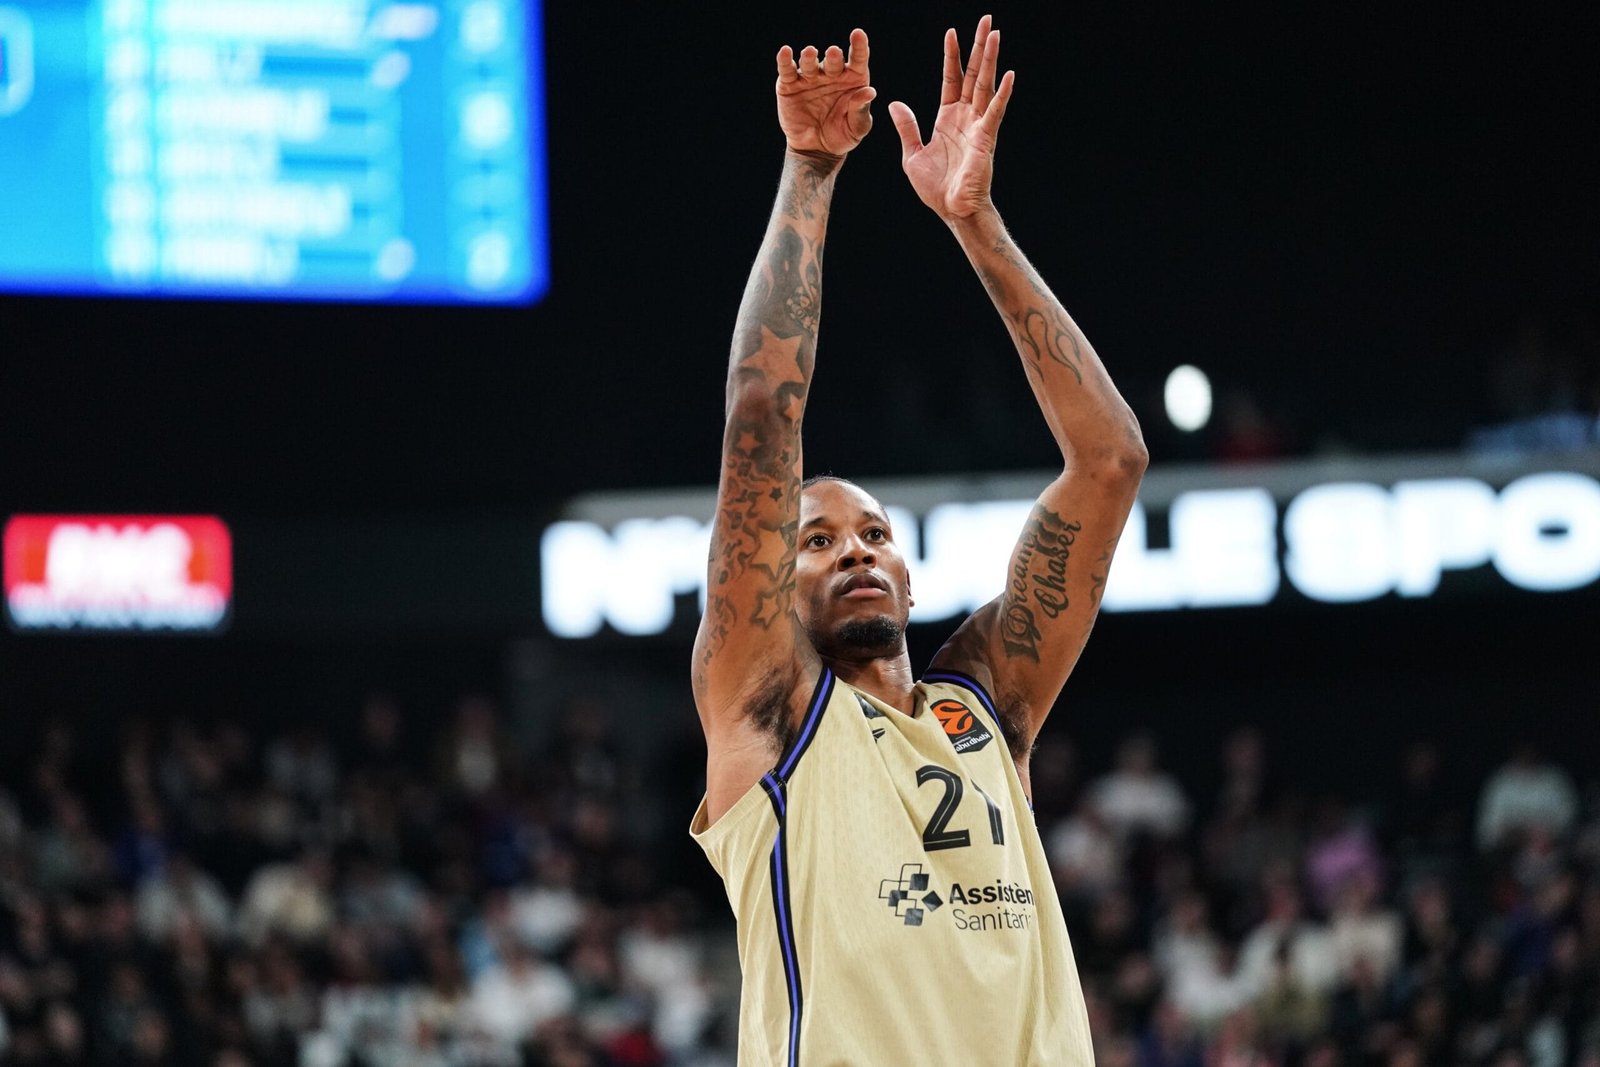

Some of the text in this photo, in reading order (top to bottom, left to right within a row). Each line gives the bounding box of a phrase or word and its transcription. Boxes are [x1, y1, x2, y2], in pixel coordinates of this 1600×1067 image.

[1031, 520, 1082, 619] Chaser
[915, 764, 1005, 852] 21
[952, 906, 1032, 932] Sanitàri
